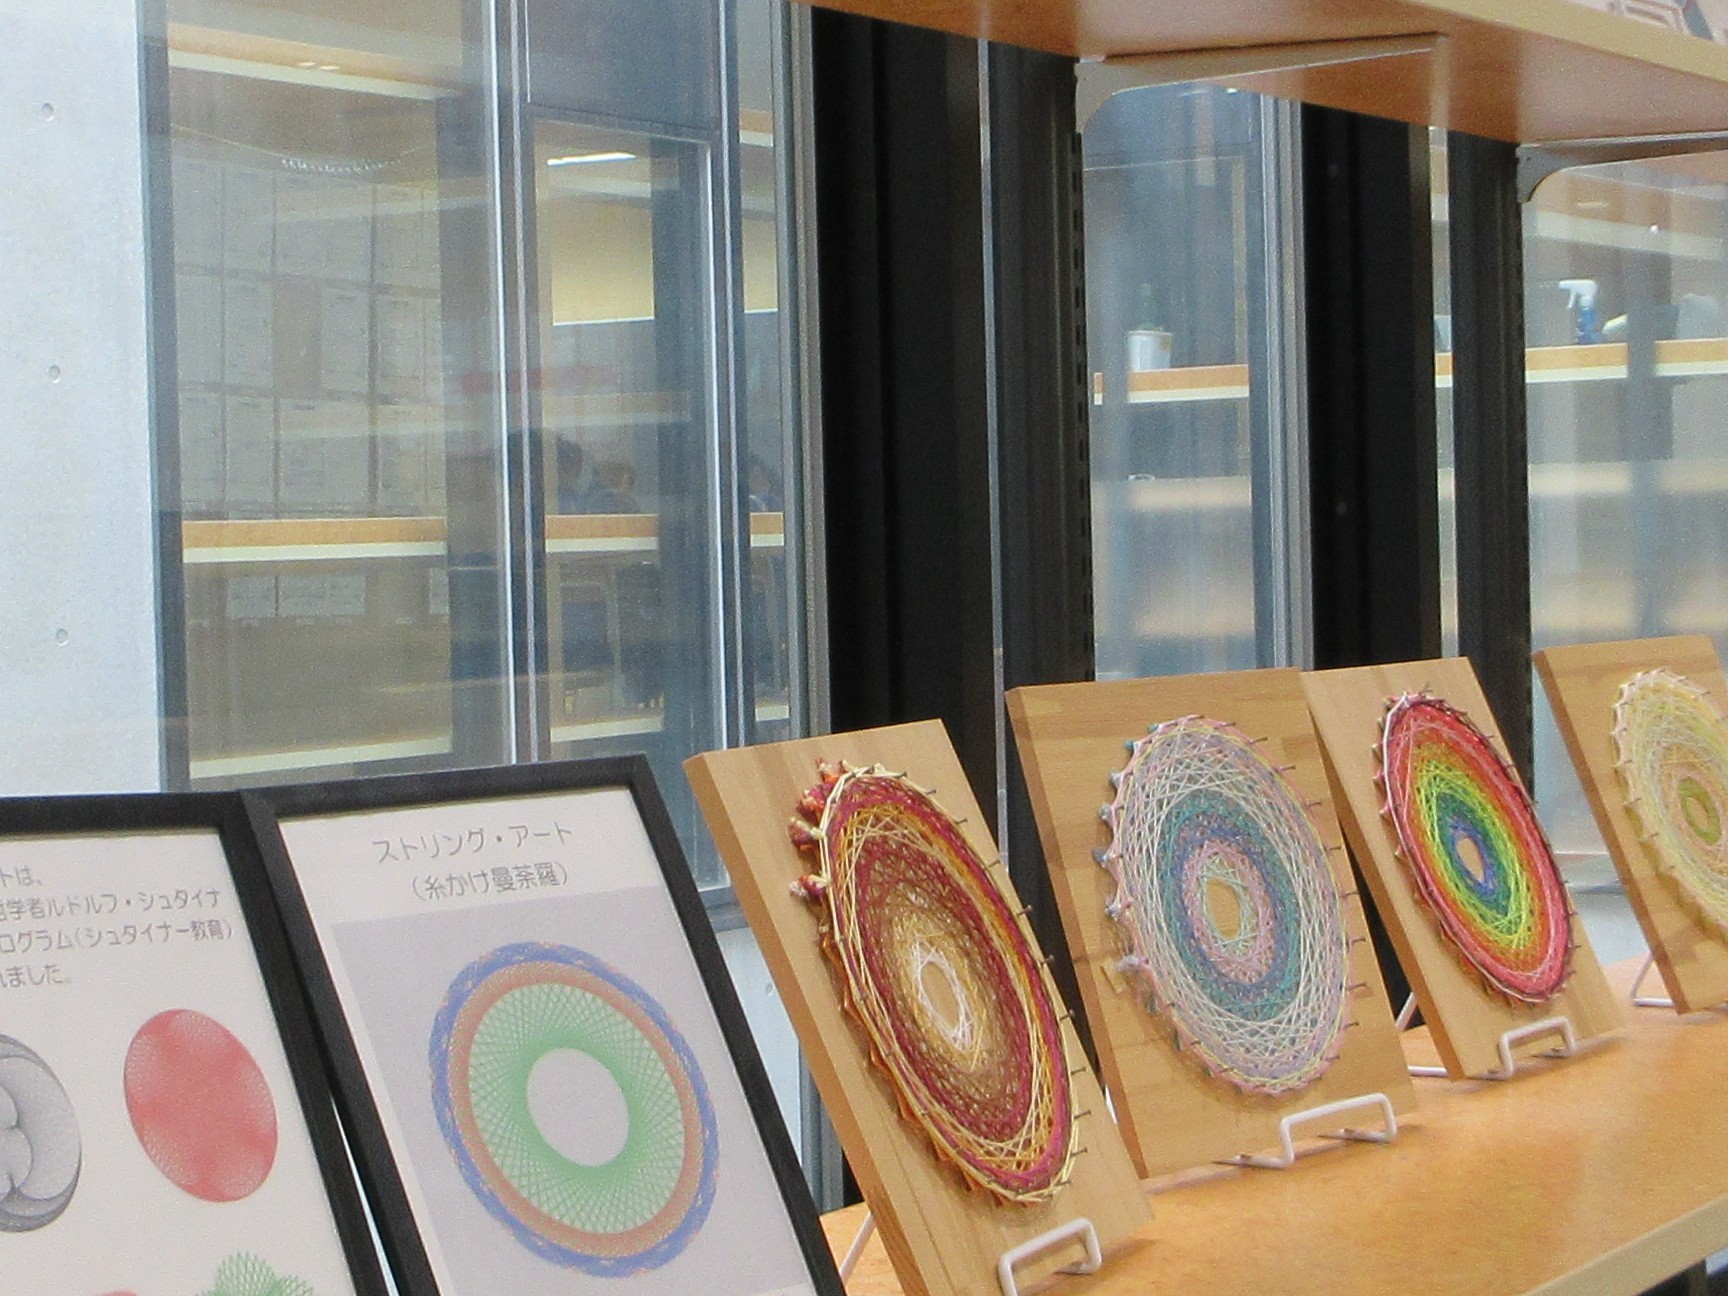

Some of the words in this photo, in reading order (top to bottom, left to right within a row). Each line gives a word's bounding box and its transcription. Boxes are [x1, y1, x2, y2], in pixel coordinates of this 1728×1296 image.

[371, 821, 572, 864] ストリング・アート
